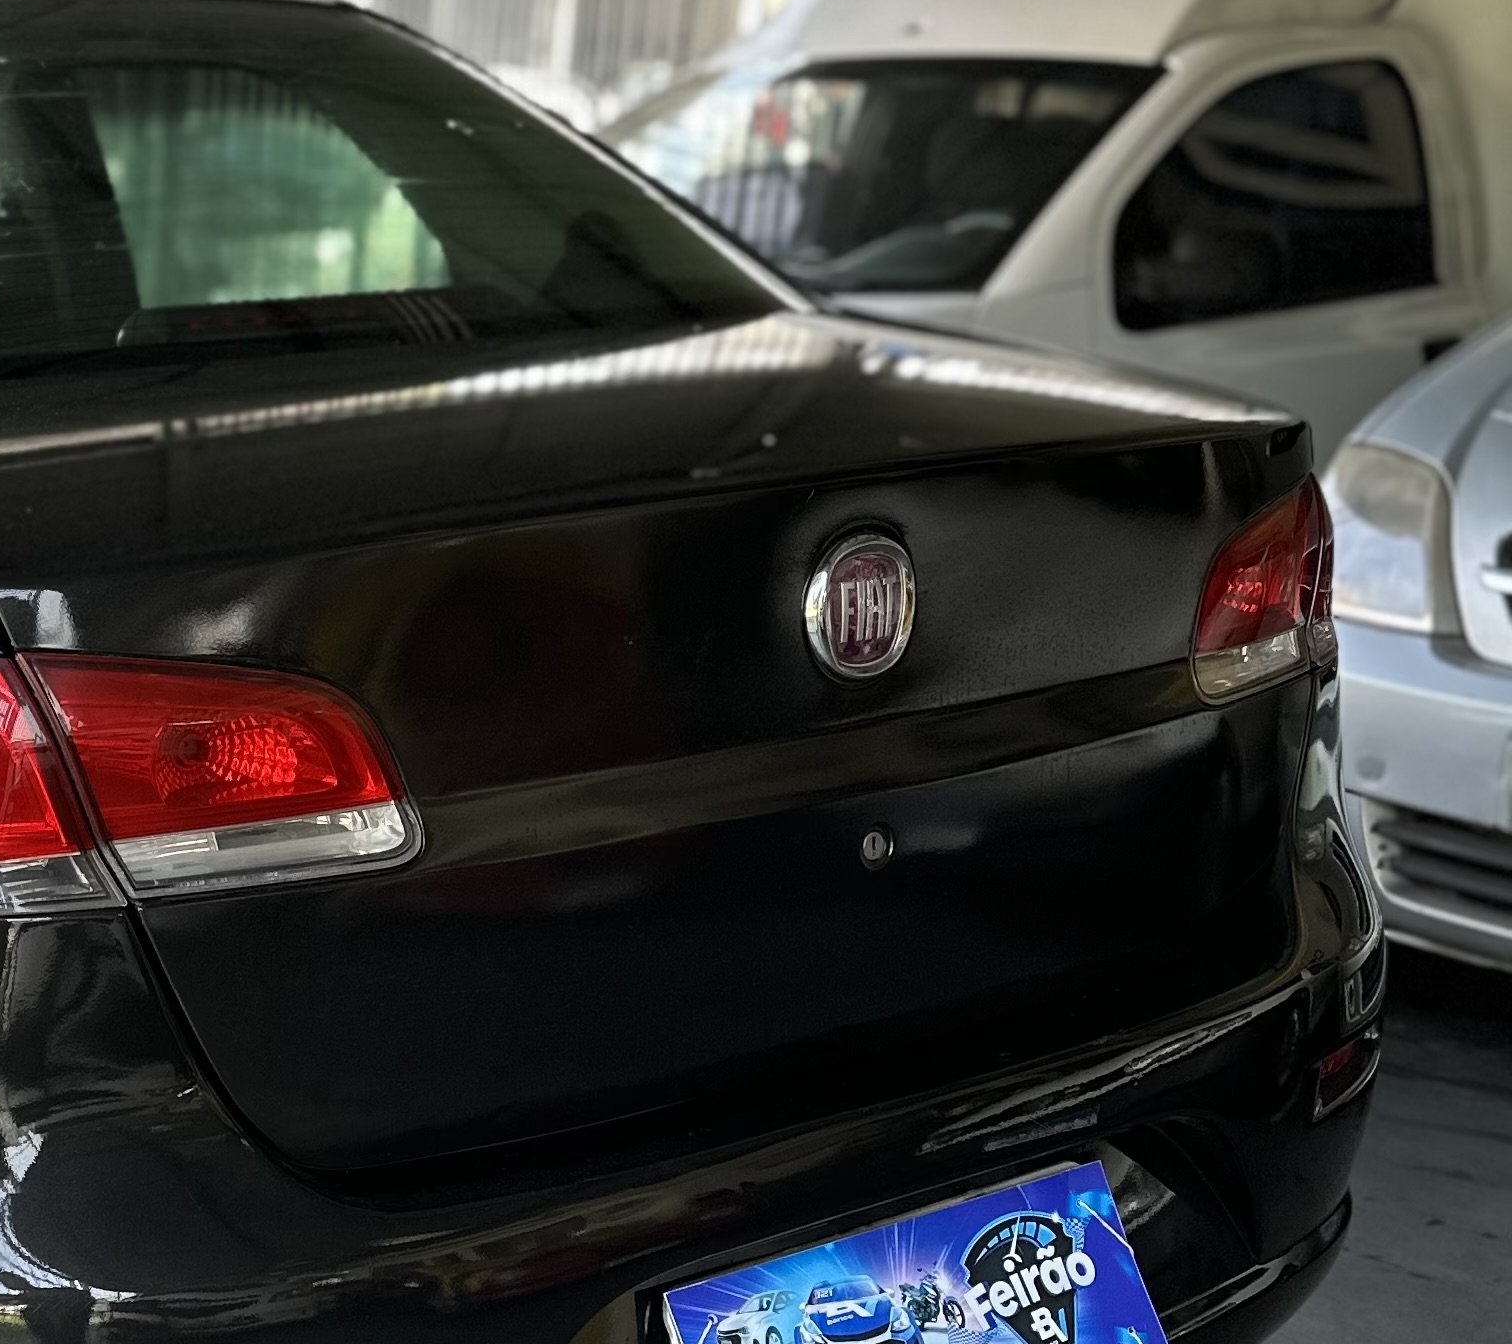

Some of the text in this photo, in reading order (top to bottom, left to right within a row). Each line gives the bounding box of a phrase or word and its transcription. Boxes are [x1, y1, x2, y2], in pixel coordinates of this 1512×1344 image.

[840, 575, 897, 643] FIAT
[964, 1246, 1096, 1332] Feirão
[1030, 1306, 1069, 1343] BV
